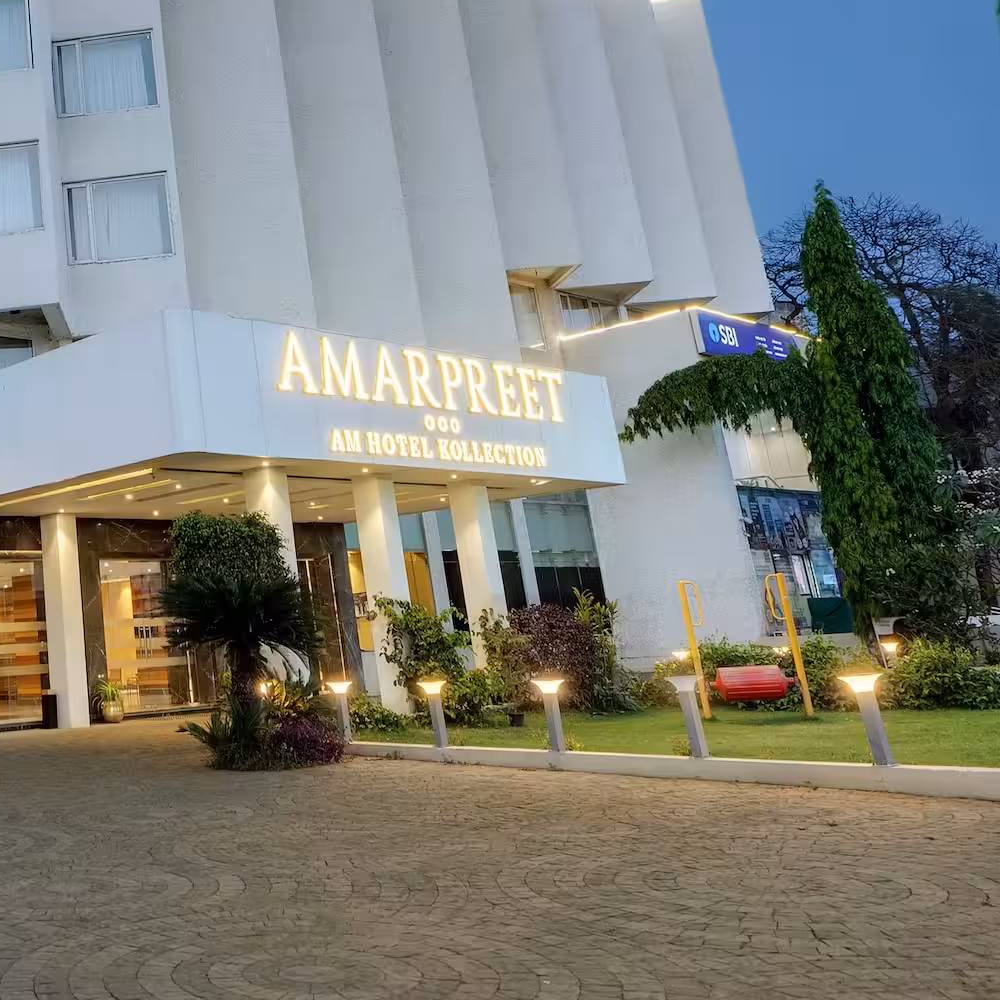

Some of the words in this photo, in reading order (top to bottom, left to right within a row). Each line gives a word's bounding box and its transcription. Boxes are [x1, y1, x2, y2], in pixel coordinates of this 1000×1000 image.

[718, 324, 739, 348] SBI
[276, 330, 564, 423] AMARPREET
[330, 427, 362, 453] AM
[366, 431, 434, 459] HOTEL
[436, 438, 546, 468] KOLLECTION
